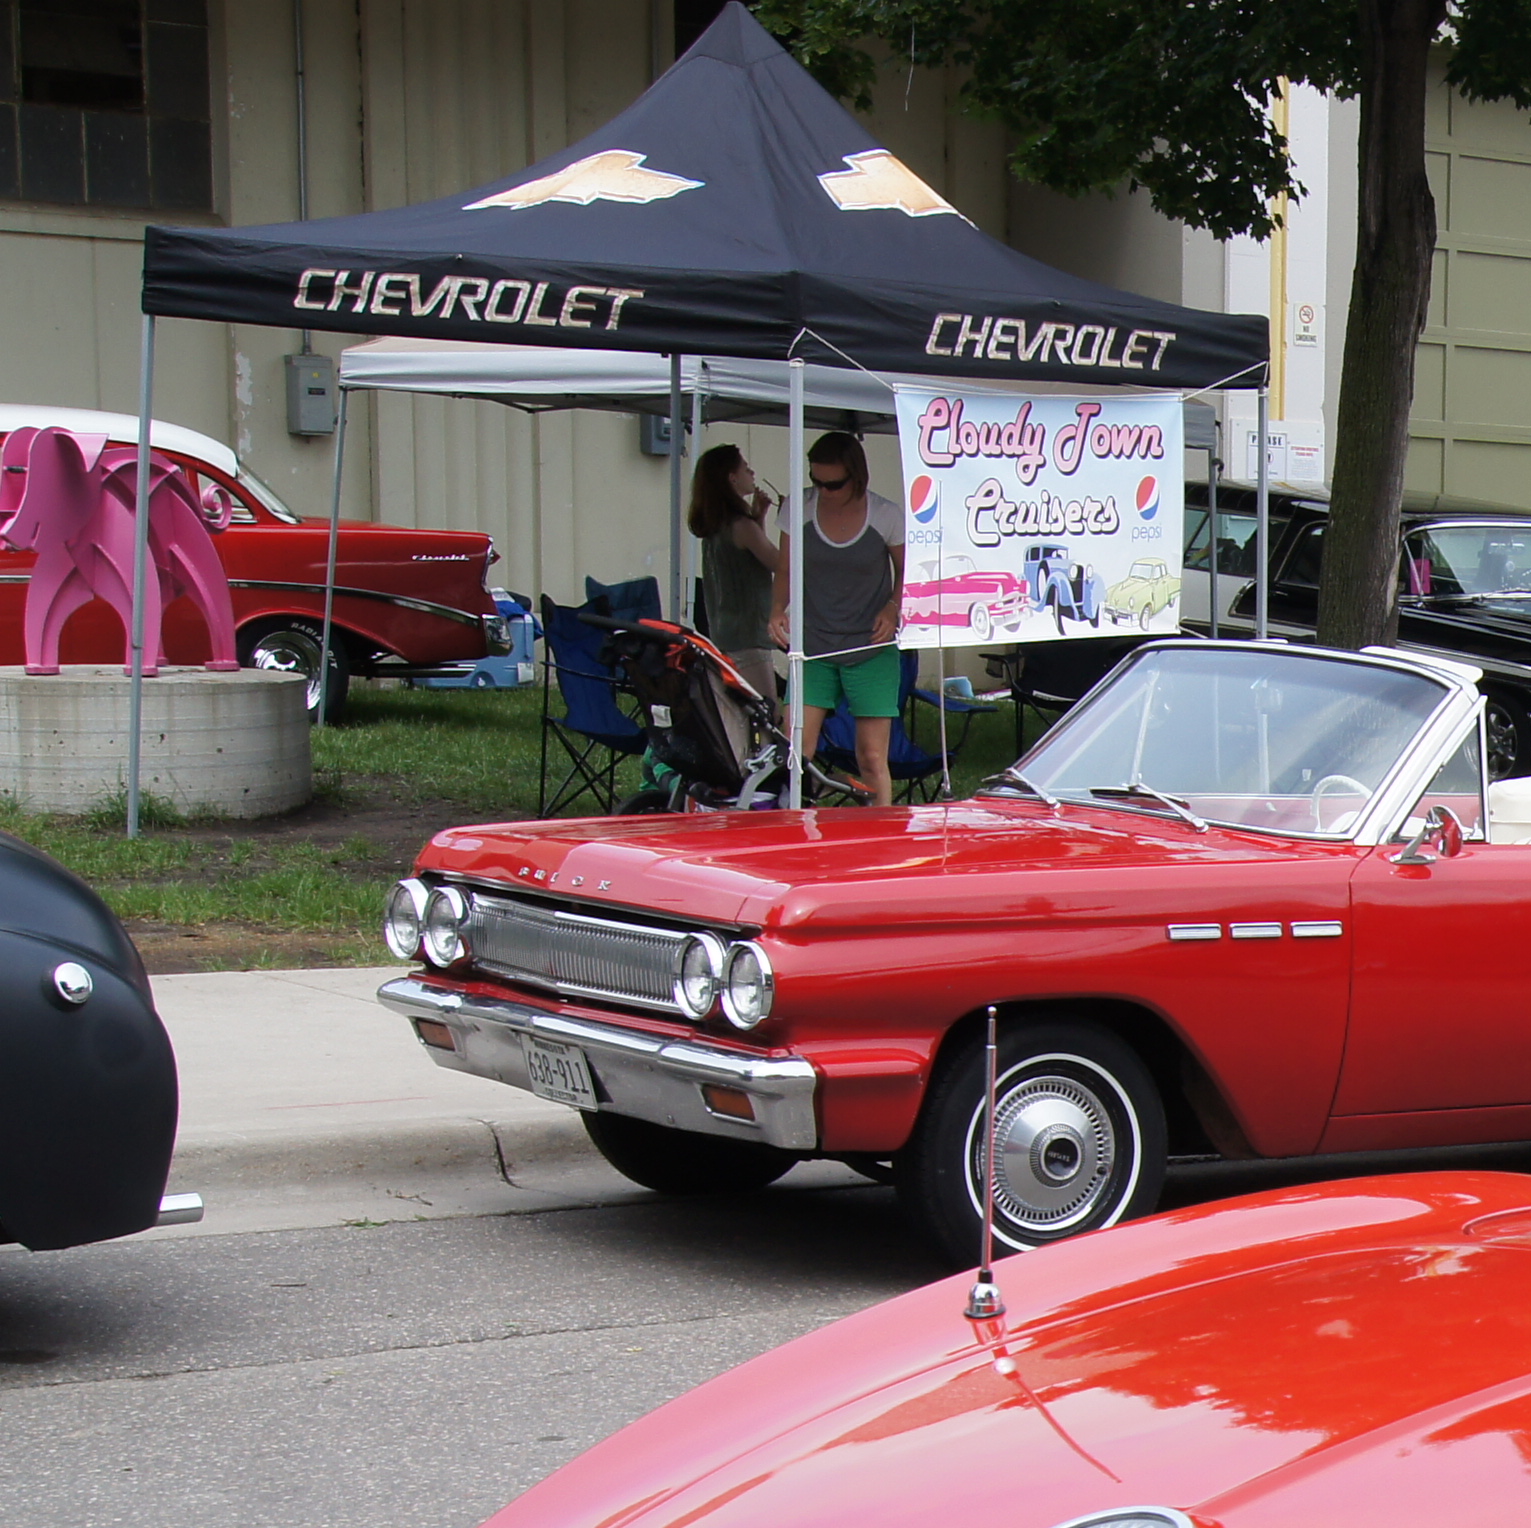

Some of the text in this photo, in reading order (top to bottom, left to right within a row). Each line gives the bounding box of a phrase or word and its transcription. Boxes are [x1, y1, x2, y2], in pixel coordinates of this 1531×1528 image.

[293, 267, 645, 331] CHEVROLET
[925, 312, 1177, 371] CHEVROLET
[917, 396, 1165, 486] Cloudy Town
[908, 527, 943, 548] pepsi
[965, 477, 1120, 549] Cruisers
[1131, 523, 1162, 543] pepsi
[528, 1050, 590, 1094] 638-911
